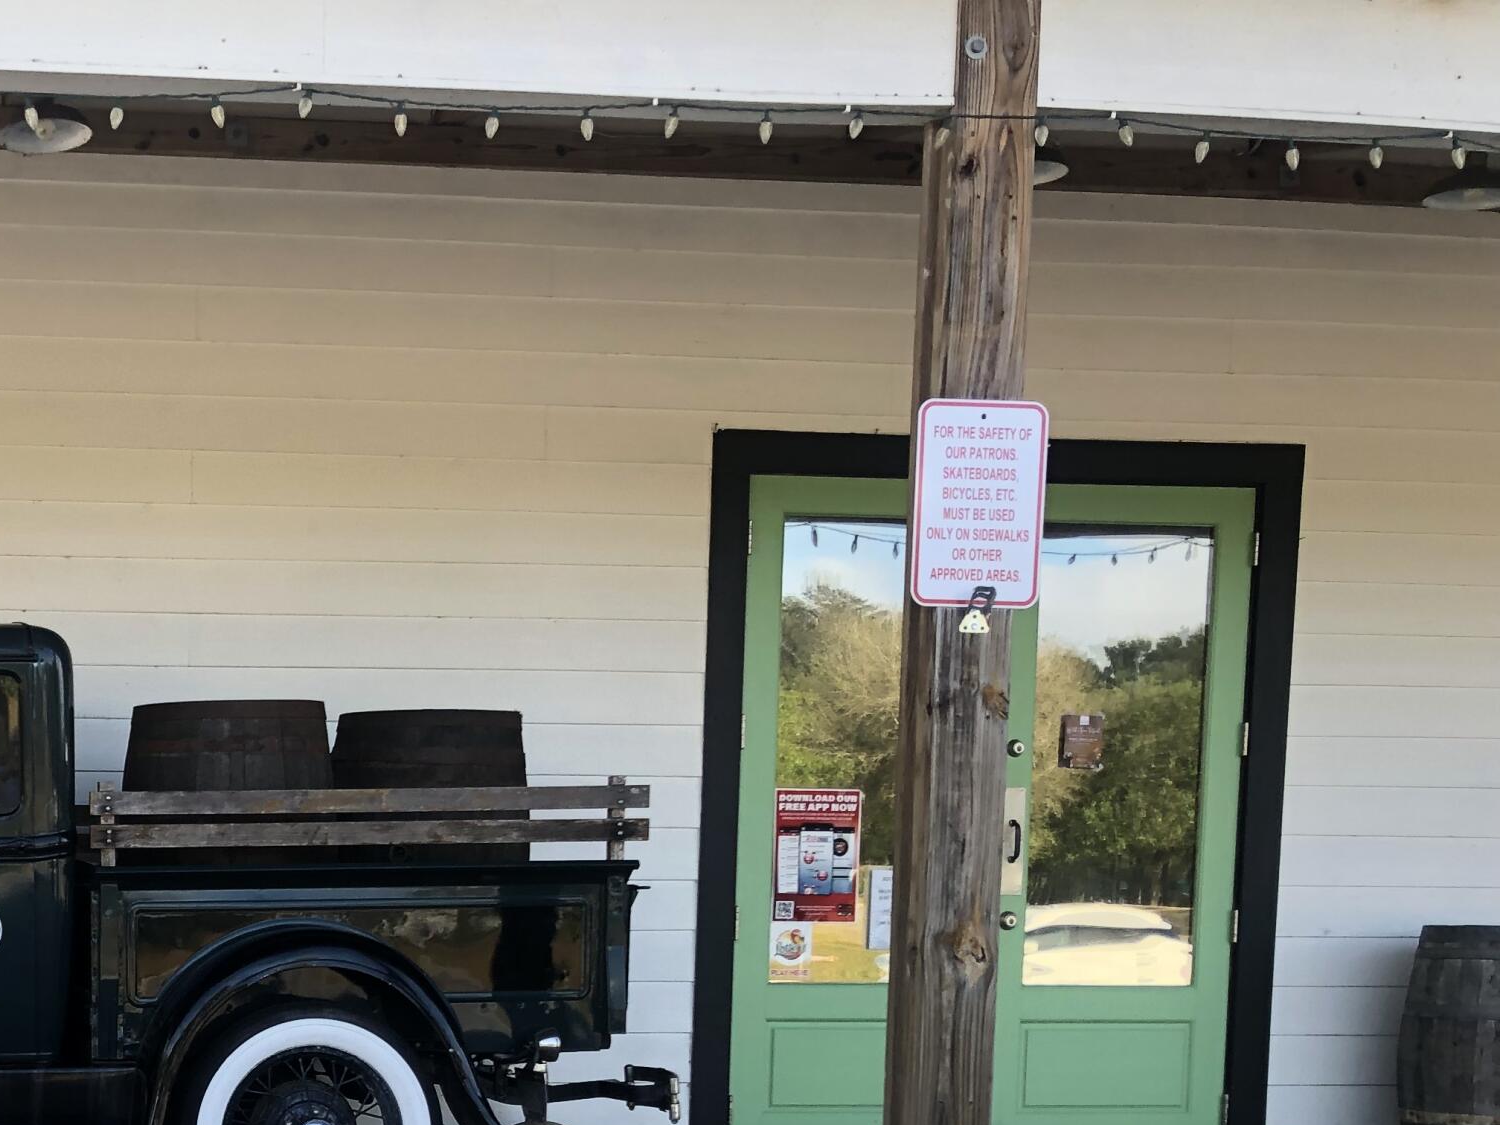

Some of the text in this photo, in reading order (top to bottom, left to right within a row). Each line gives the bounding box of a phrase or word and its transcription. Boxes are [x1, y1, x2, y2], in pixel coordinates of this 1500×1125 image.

[934, 425, 1032, 441] FOR THE SAFETY OF
[945, 446, 966, 459] OUR
[943, 466, 1019, 483] SKATEBOARDS,
[942, 487, 1017, 502] BICYCLES, ETC.
[943, 507, 1015, 522] MUST BE USED
[926, 527, 1029, 543] ONLY ON SIDEWALKS
[952, 548, 1002, 561] OR OTHER
[930, 568, 1021, 583] APPROVED AREAS.
[779, 794, 858, 803] DOWNLOAD OUR
[778, 803, 857, 812] FREE APP NOW
